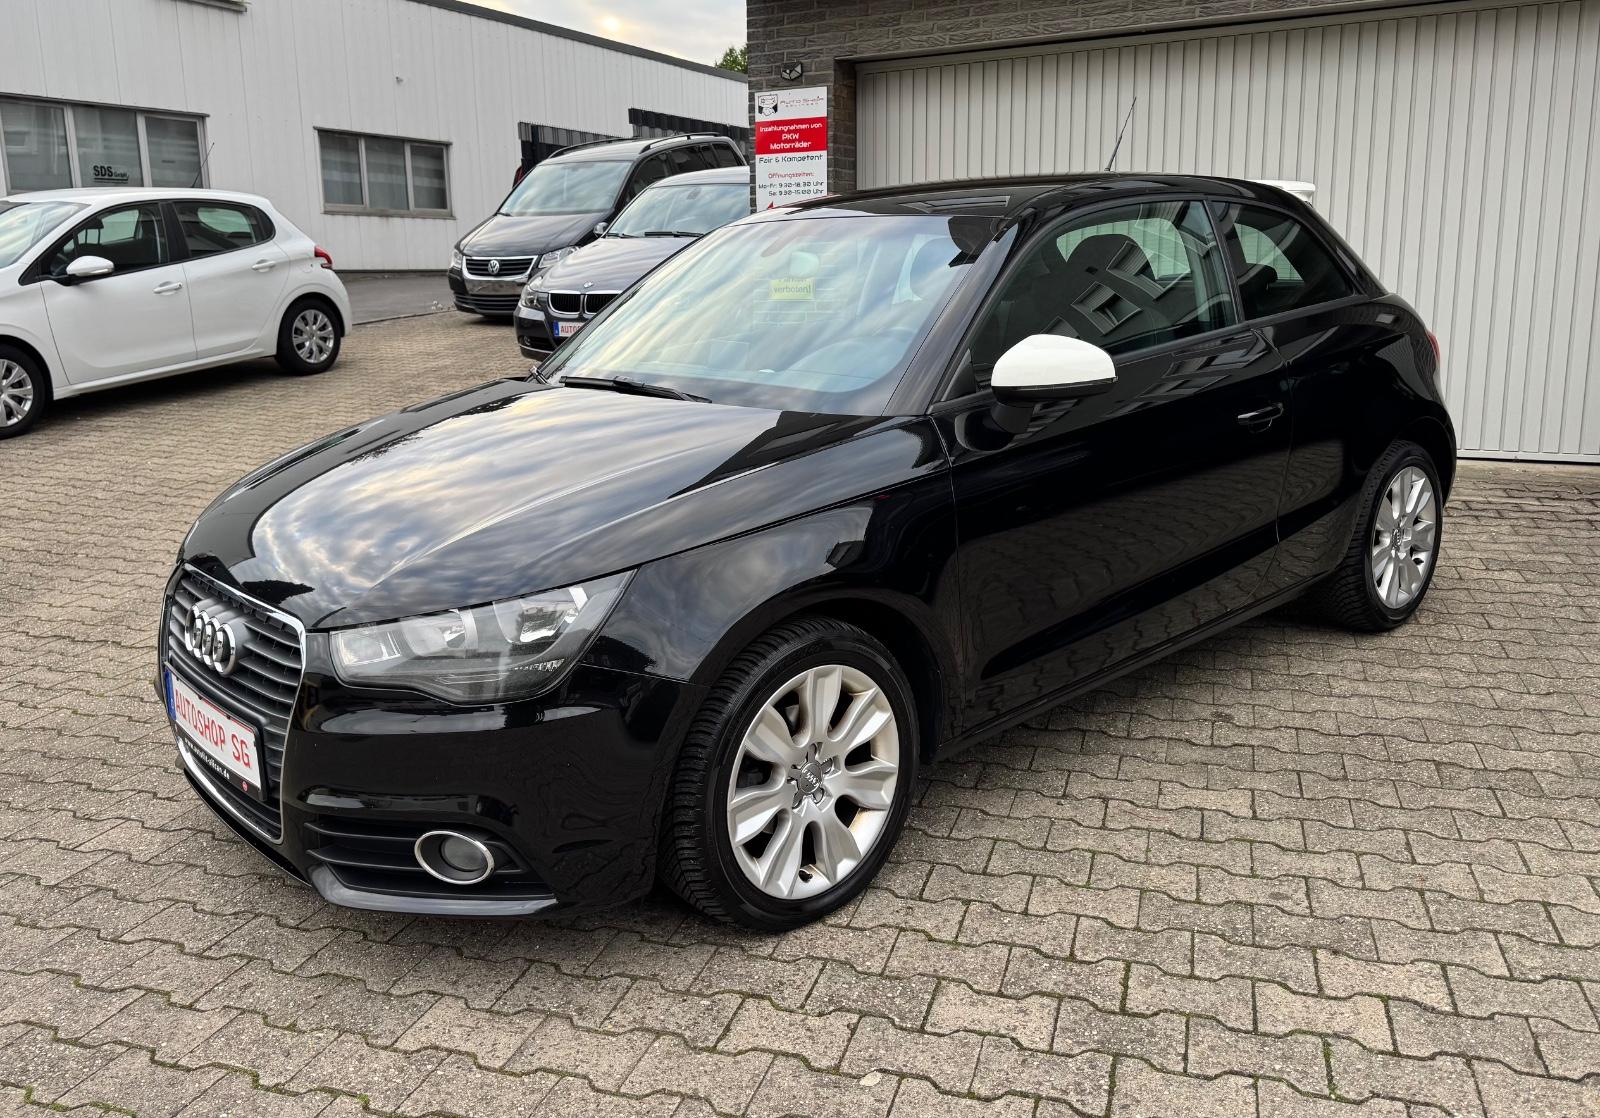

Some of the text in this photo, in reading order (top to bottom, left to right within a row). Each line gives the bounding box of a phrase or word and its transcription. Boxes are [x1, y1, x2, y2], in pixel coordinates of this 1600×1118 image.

[769, 140, 811, 150] Motorräder
[781, 154, 823, 163] Kompetent
[93, 165, 113, 177] SDS
[175, 689, 251, 769] AUTOSHOP SG
